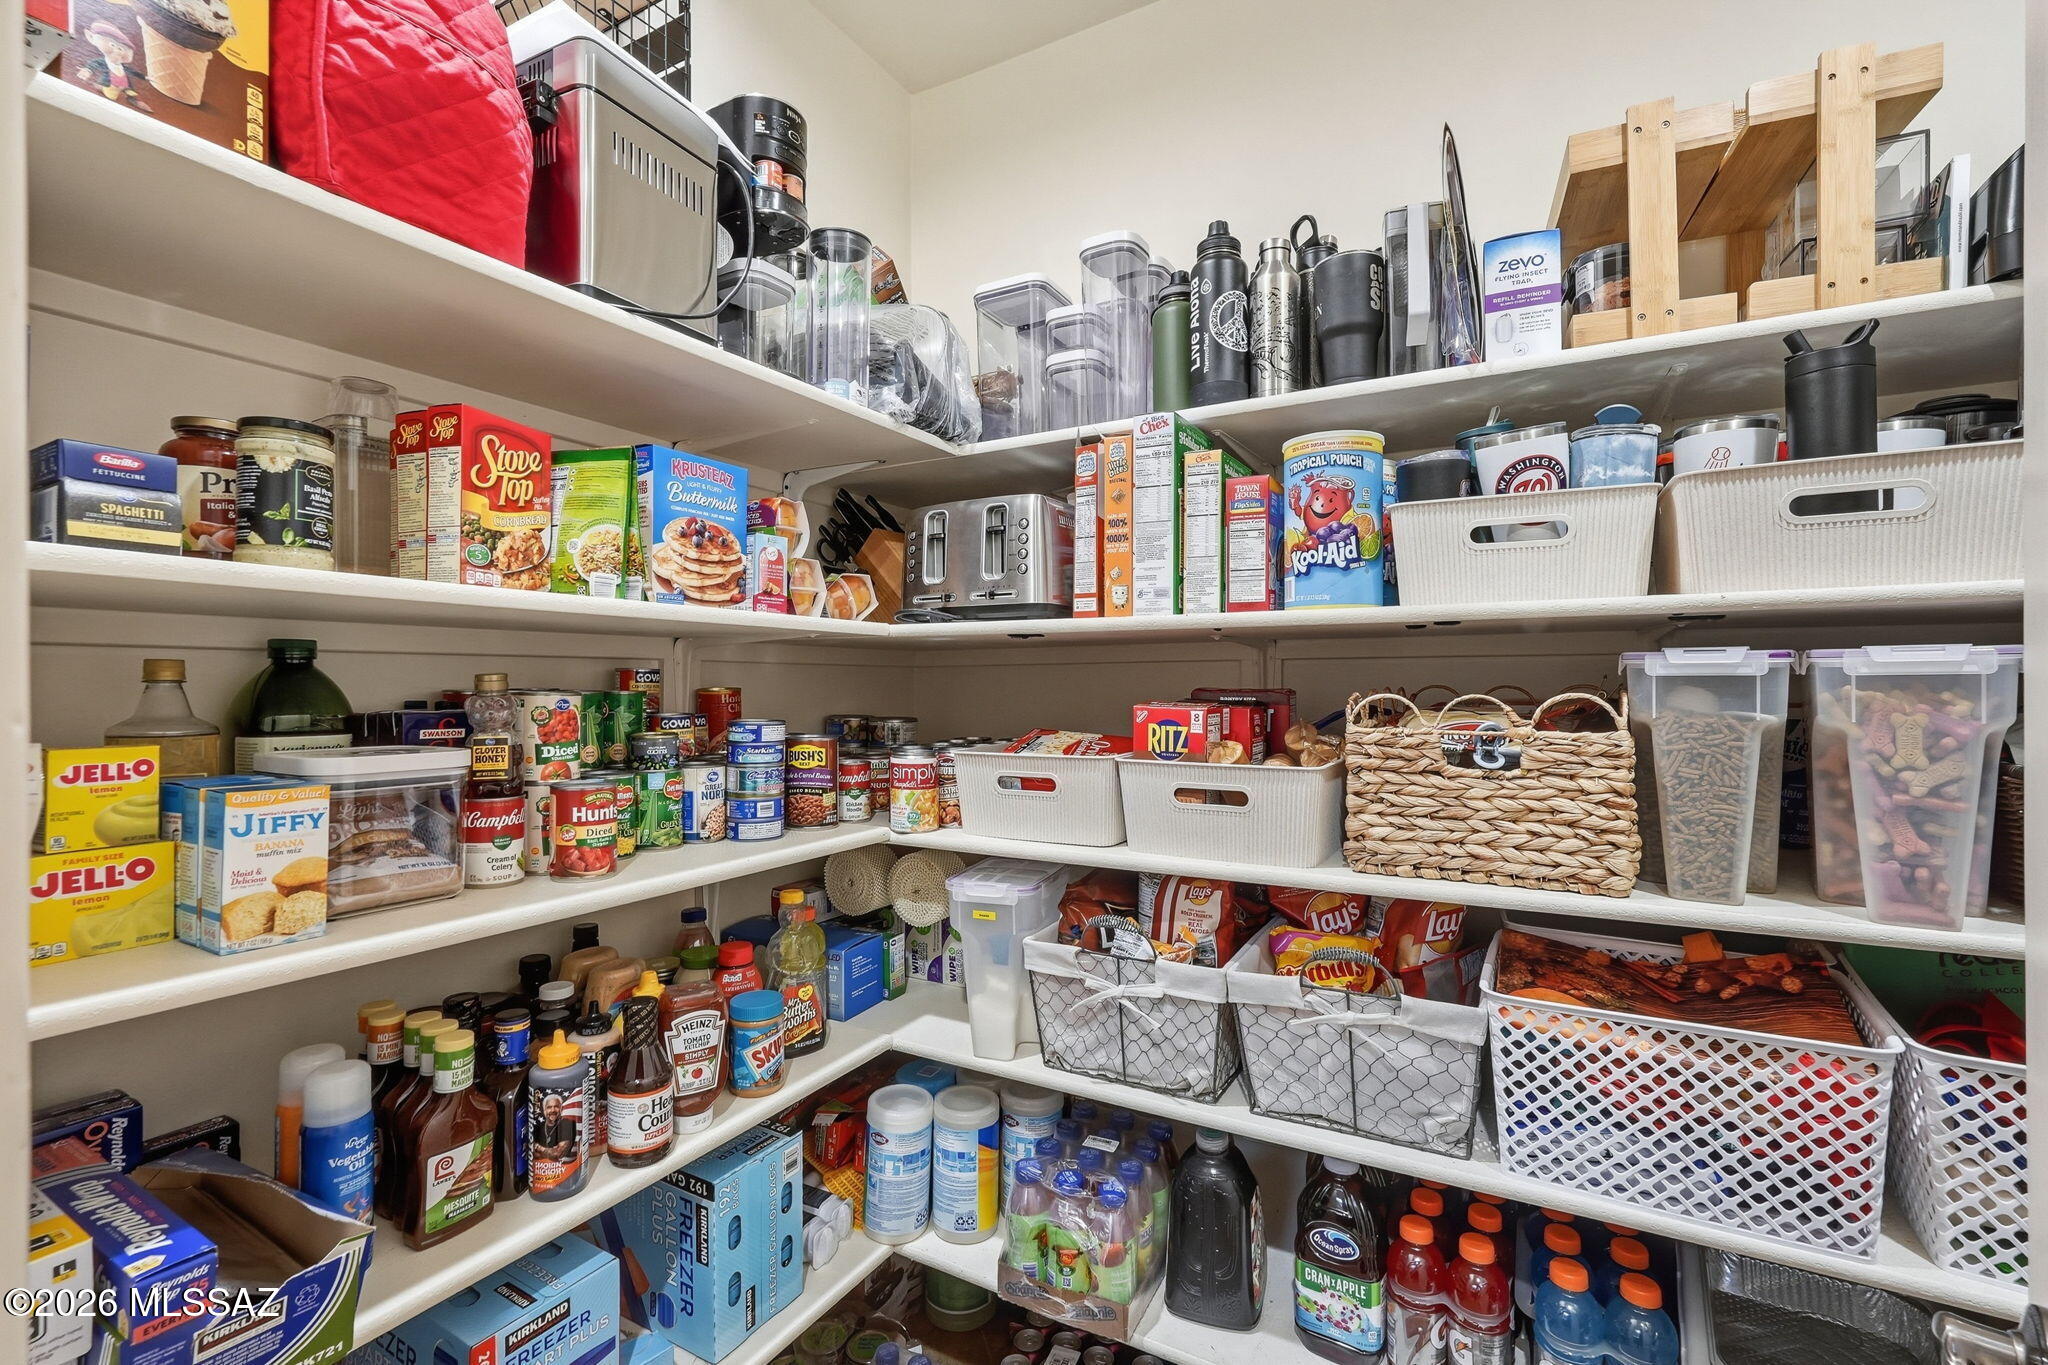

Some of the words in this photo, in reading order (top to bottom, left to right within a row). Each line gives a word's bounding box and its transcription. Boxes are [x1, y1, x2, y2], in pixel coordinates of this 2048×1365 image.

[1494, 273, 1520, 282] FLYING
[1522, 268, 1549, 278] INSECT
[1493, 295, 1515, 304] REFILL
[1517, 289, 1552, 299] REMINDER
[1190, 332, 1200, 372] Live
[398, 422, 424, 444] Stove
[430, 415, 458, 437] Stove
[439, 425, 454, 441] Top
[1140, 418, 1170, 434] Chex
[406, 433, 420, 448] Top
[471, 434, 543, 488] Stove
[1290, 454, 1328, 475] TROPICAL
[1330, 453, 1362, 468] PUNCH
[92, 468, 146, 481] FETTUCCINE
[671, 458, 736, 491] KRUSTEAZ
[1498, 457, 1565, 490] WASHINGTON
[200, 472, 236, 494] Pr
[498, 472, 534, 507] Top
[1235, 484, 1260, 492] TOWN
[667, 481, 738, 514] Buttermilk
[1235, 491, 1260, 500] HOUSE
[100, 502, 164, 520] SPAGHETTI
[207, 502, 235, 510] Italia
[493, 516, 549, 528] CORNBREAD
[1291, 534, 1358, 575] Kool-Aid
[661, 719, 691, 730] GOYA
[1194, 713, 1200, 722] 8
[421, 729, 464, 738] SWANSON
[1148, 723, 1189, 754] RITZ
[475, 747, 506, 755] CLOVER
[541, 743, 579, 758] Diced
[789, 751, 823, 763] BUSH'S
[475, 755, 506, 764] HONEY
[60, 758, 155, 785] JELL-O
[893, 764, 937, 783] simply
[89, 786, 123, 794] lemon
[232, 793, 276, 804] Quality
[279, 791, 290, 800] &
[292, 788, 326, 799] Value!
[701, 790, 725, 800] NORT
[586, 827, 613, 836] Diced
[255, 839, 304, 851] BANANA
[256, 848, 284, 858] muffin
[62, 855, 101, 866] FAMILY
[103, 852, 124, 861] SIZE
[491, 863, 513, 871] Celery
[30, 857, 155, 898] JELL-O
[230, 875, 267, 886] Delicious
[231, 869, 253, 879] Moist
[493, 873, 512, 881] SOUP
[72, 894, 110, 906] lemon
[1189, 886, 1212, 899] Lay's
[1310, 900, 1361, 935] Lay's
[949, 955, 957, 983] WIPE
[1943, 966, 2022, 977] COLLE
[681, 1019, 712, 1033] HEINZ
[378, 1033, 388, 1042] NO
[682, 1034, 712, 1046] TOMATO
[377, 1045, 384, 1053] 15
[684, 1041, 710, 1051] KETCHUP
[751, 1034, 783, 1069] SKIP
[684, 1050, 709, 1061] SIMPLY
[451, 1060, 463, 1069] NO
[638, 1110, 673, 1132] Coun
[718, 1131, 769, 1161] FREEZER
[348, 1158, 366, 1172] Oil
[535, 1167, 566, 1176] HICKORY
[769, 1161, 777, 1197] BAGS
[689, 1180, 708, 1195] 192
[732, 1178, 740, 1209] BAGS
[69, 1178, 120, 1214] Wrap
[444, 1188, 480, 1214] MESQUITE
[719, 1184, 733, 1218] 192
[652, 1187, 663, 1245] PLUS
[90, 1202, 173, 1256] Reynolds
[769, 1203, 777, 1252] GALLON
[664, 1191, 678, 1287] GALLON
[698, 1208, 708, 1266] KIRKLAND
[1313, 1233, 1334, 1252] Ocean
[1335, 1244, 1355, 1255] Spray
[679, 1196, 694, 1317] FREEZER
[152, 1263, 210, 1292] Reynolds
[516, 1258, 566, 1290] FREEZER
[769, 1255, 777, 1313] FREEZER
[496, 1285, 532, 1308] KIRKLAND
[508, 1302, 569, 1346] KIRKLAND
[505, 1309, 591, 1365] FREEZER
[569, 1314, 610, 1351] PLUS
